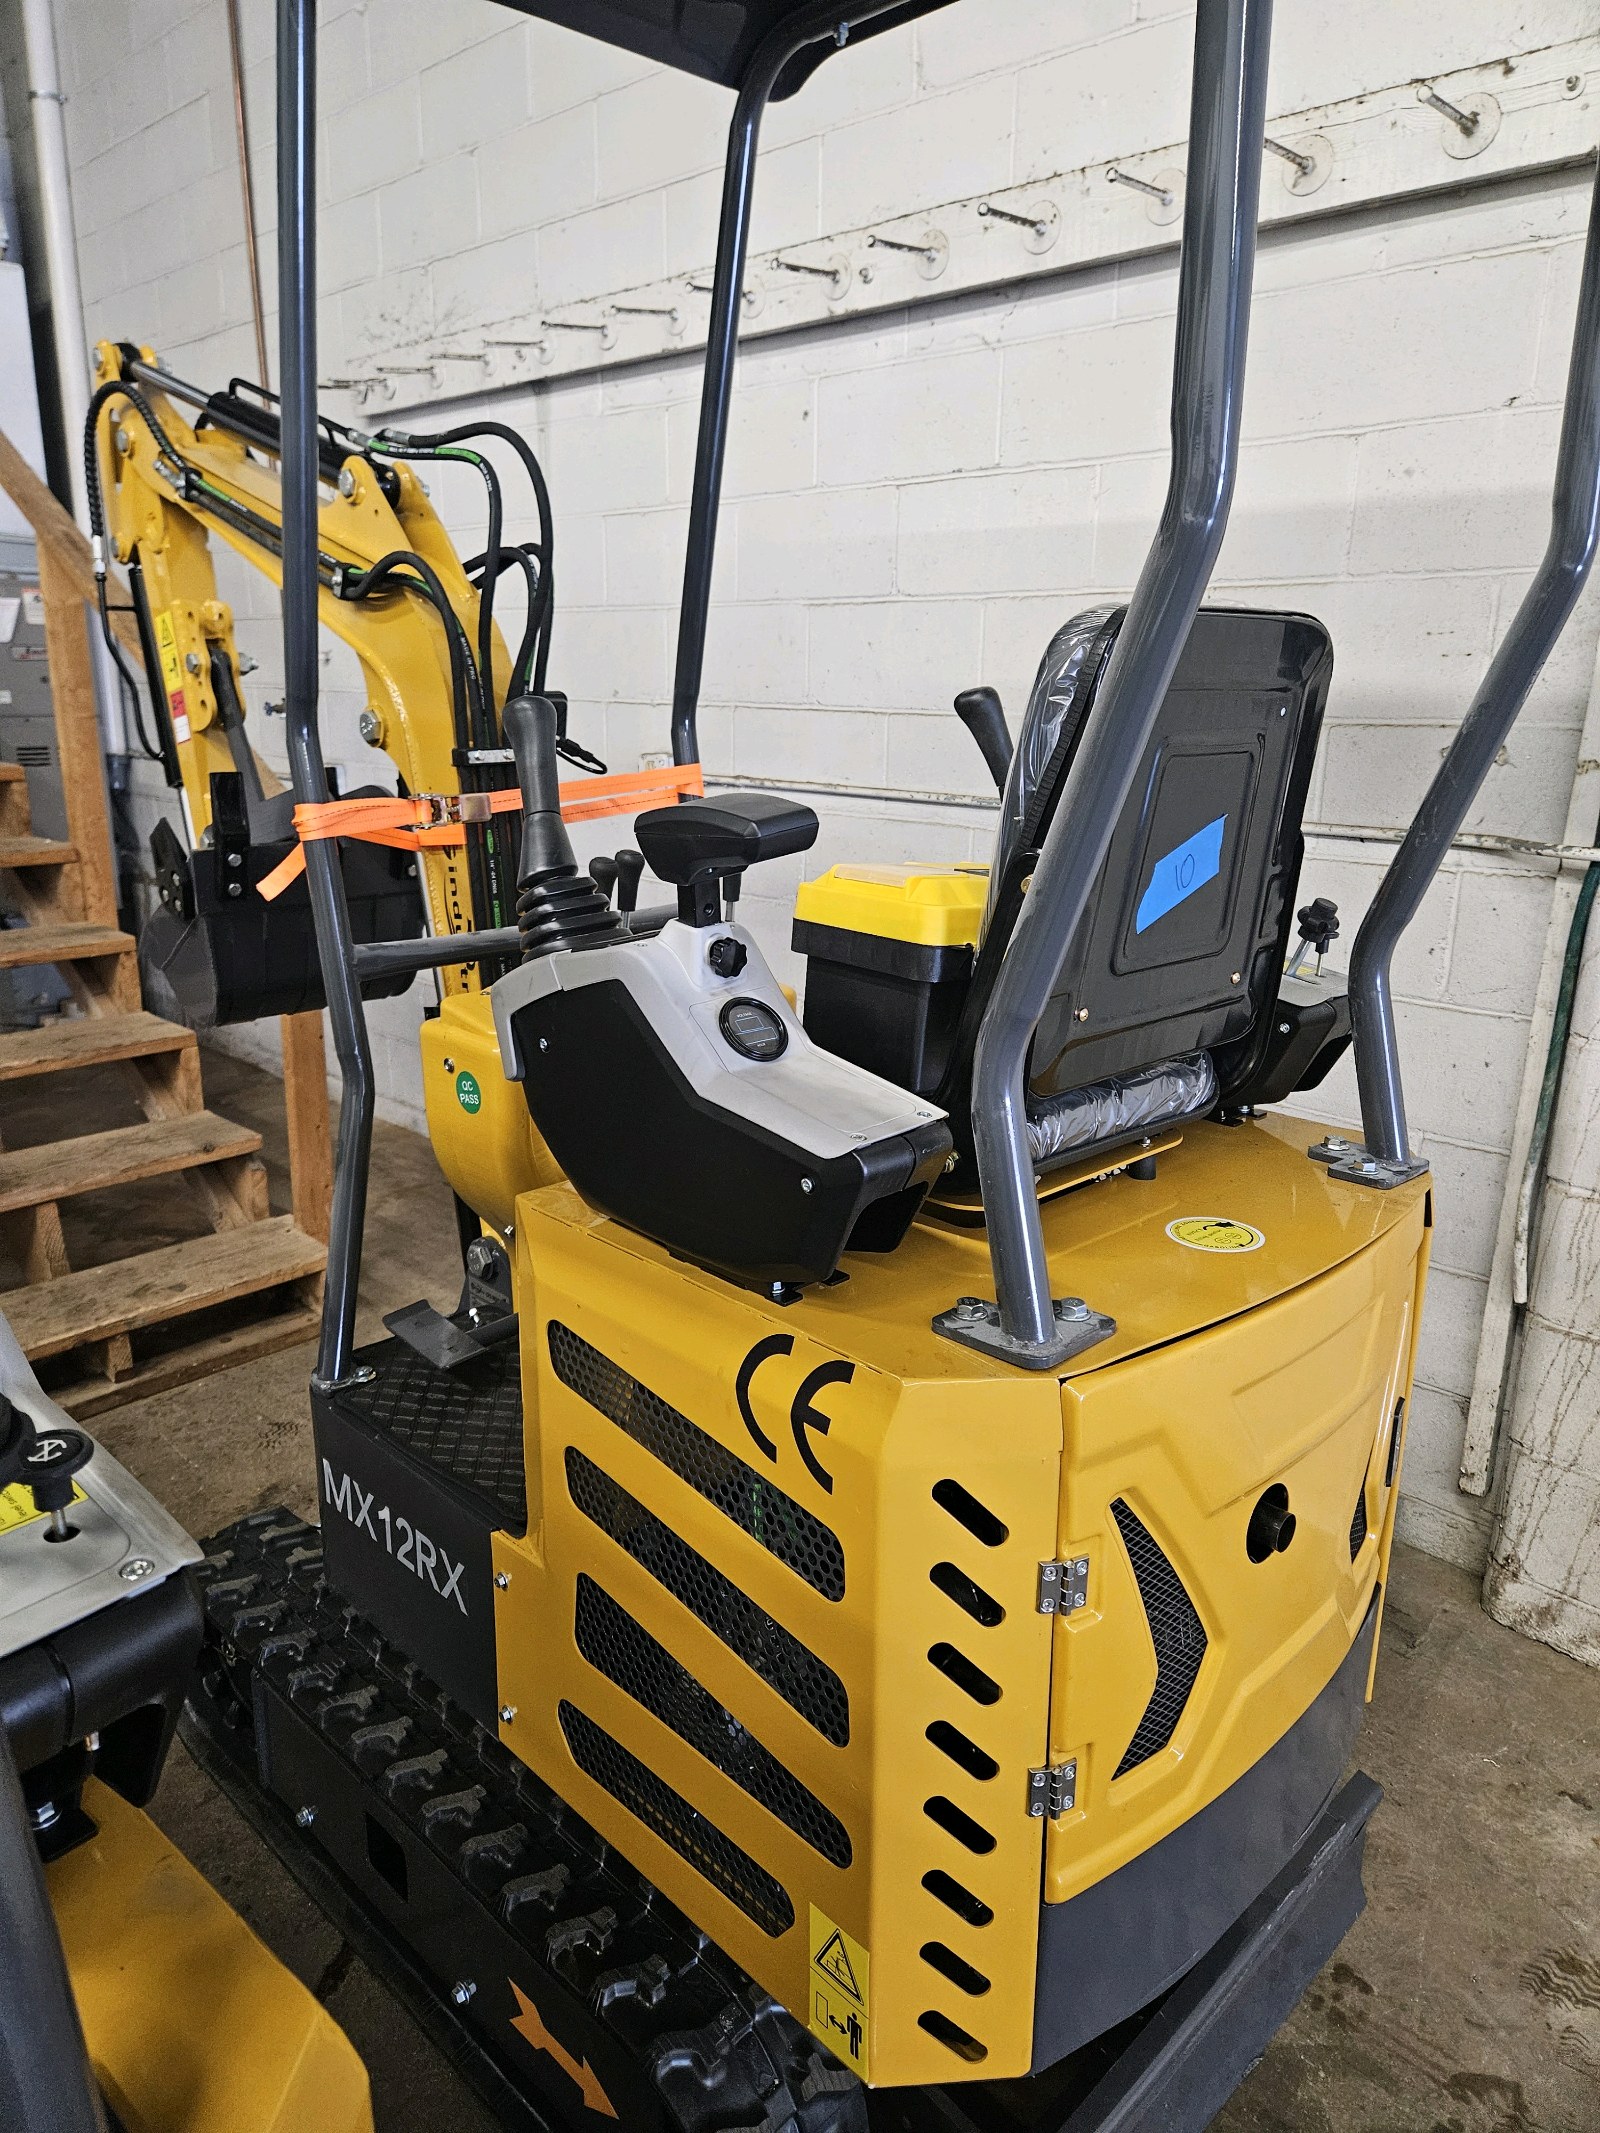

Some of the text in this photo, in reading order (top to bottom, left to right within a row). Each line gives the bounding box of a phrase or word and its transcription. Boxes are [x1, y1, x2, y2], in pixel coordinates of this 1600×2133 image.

[1175, 853, 1195, 891] 10
[459, 1093, 480, 1105] PASS
[461, 1080, 474, 1091] QC
[735, 1333, 856, 1496] CE
[322, 1457, 469, 1617] MX12RX
